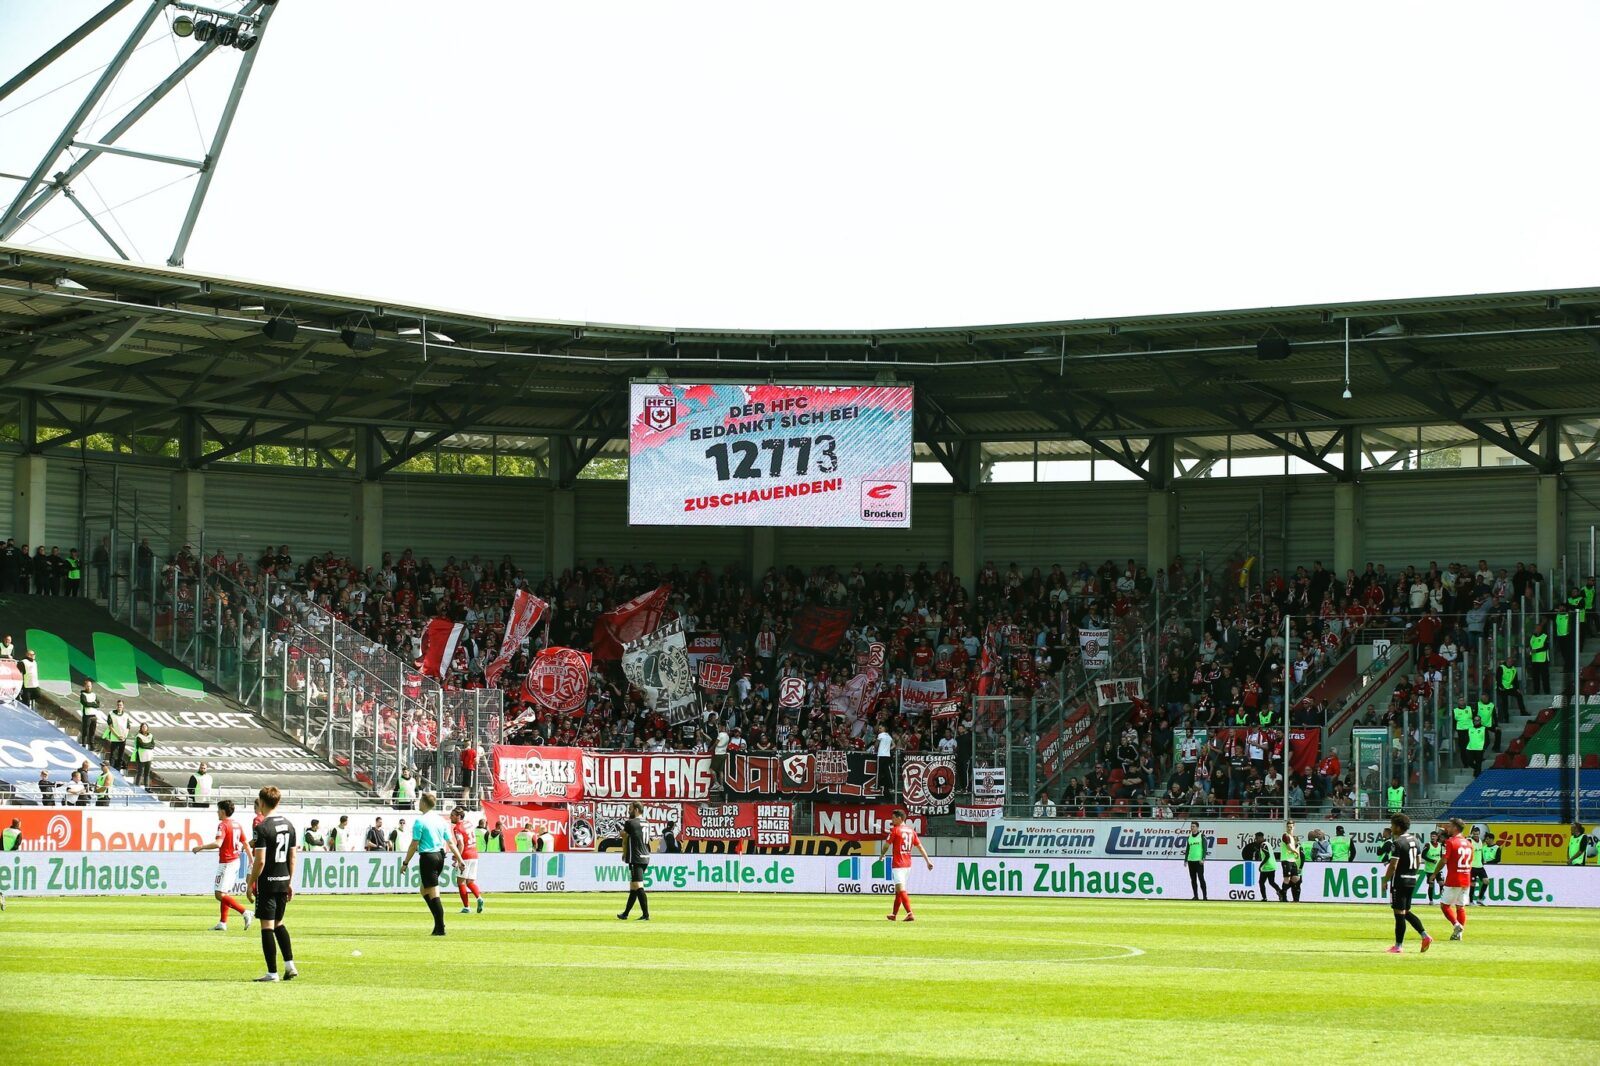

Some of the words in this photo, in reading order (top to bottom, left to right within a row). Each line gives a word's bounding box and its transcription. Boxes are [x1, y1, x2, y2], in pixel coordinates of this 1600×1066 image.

[729, 403, 766, 419] DER
[770, 396, 808, 413] HFC
[690, 418, 776, 442] BEDANKT
[781, 410, 824, 428] SICH
[830, 406, 859, 421] BEI
[705, 434, 838, 482] 12773
[683, 478, 842, 513] ZUSCHAUENDEN!
[863, 509, 903, 519] Brocken
[581, 757, 643, 798] RUDE
[649, 757, 712, 799] FANS
[572, 805, 592, 819] LPL
[722, 805, 739, 816] DER
[757, 805, 790, 817] HAFEN
[701, 816, 735, 828] GRUPPE
[275, 832, 290, 863] 21
[757, 833, 790, 845] ESSEN
[988, 825, 1096, 854] Lührmann
[1105, 826, 1216, 855] Lührman
[1516, 833, 1564, 847] LOTTO
[1457, 847, 1472, 868] 22
[47, 856, 168, 890] Zuhause.
[302, 857, 359, 888] Mein
[956, 861, 1023, 892] Mein
[1033, 862, 1163, 895] Zuhause.
[519, 881, 538, 890] GWG
[546, 881, 565, 890] GWG
[837, 883, 861, 893] GWG
[871, 883, 895, 893] GWG
[1228, 890, 1255, 900] GWG
